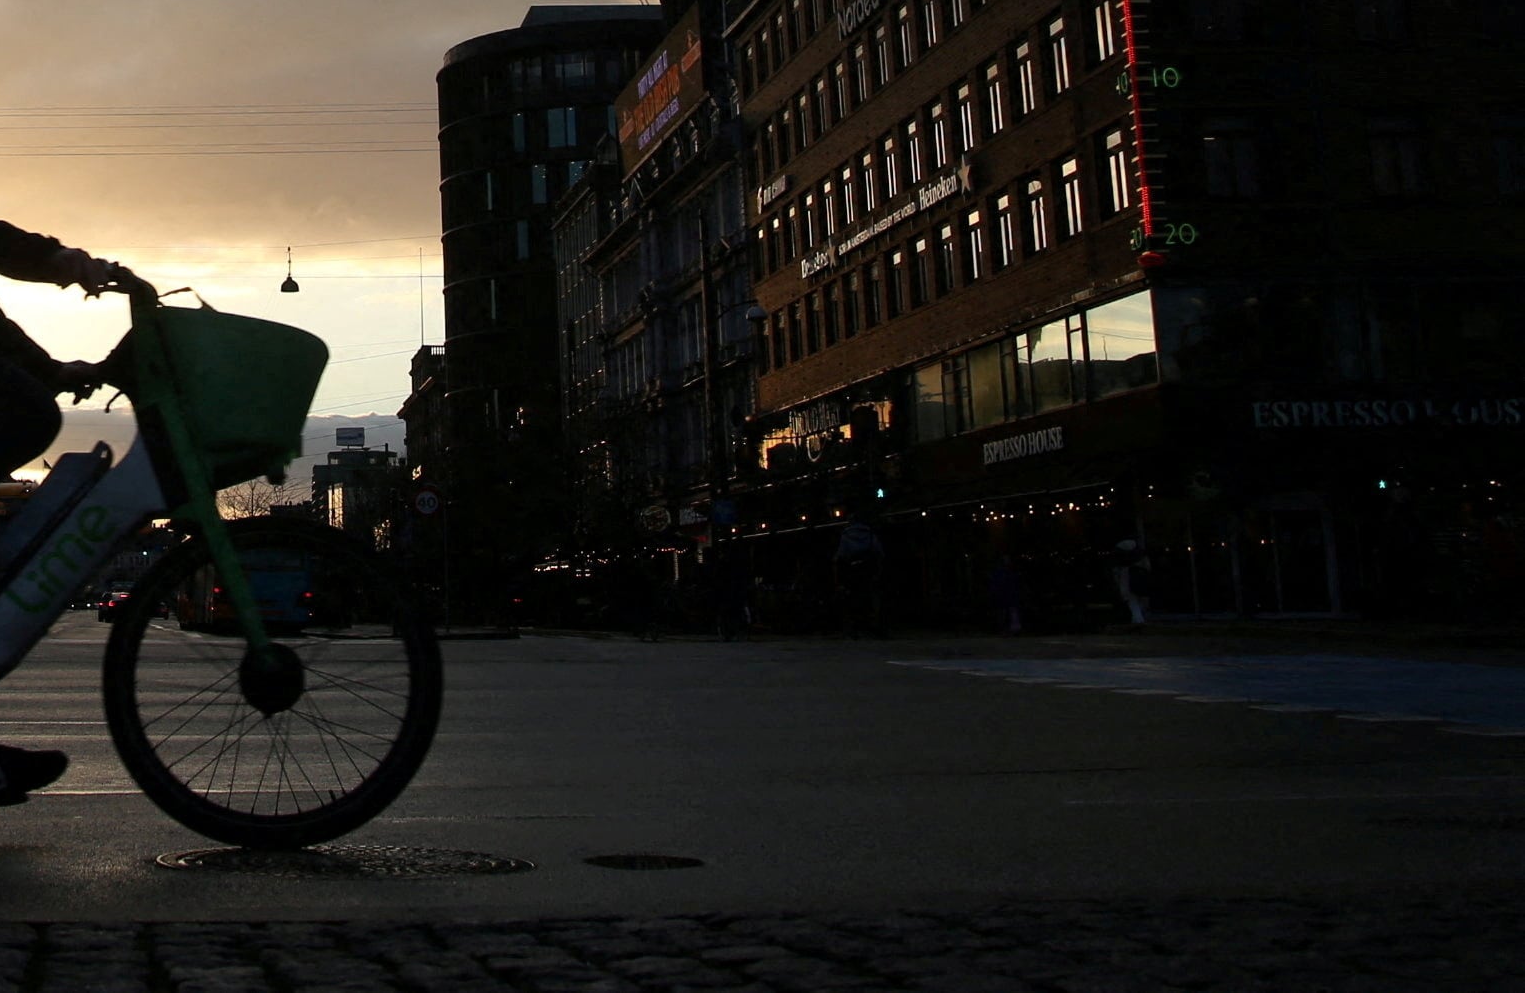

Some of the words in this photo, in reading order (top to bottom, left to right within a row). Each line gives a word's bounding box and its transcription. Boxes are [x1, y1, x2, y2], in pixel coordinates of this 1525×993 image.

[1152, 66, 1180, 88] 10
[919, 174, 959, 211] Heineken
[1163, 222, 1196, 245] 20
[1251, 399, 1418, 432] ESPRESSO
[983, 434, 1028, 465] ESPRESSO
[1027, 426, 1065, 456] HOUSE
[417, 496, 437, 509] 40
[4, 505, 118, 614] Lime
